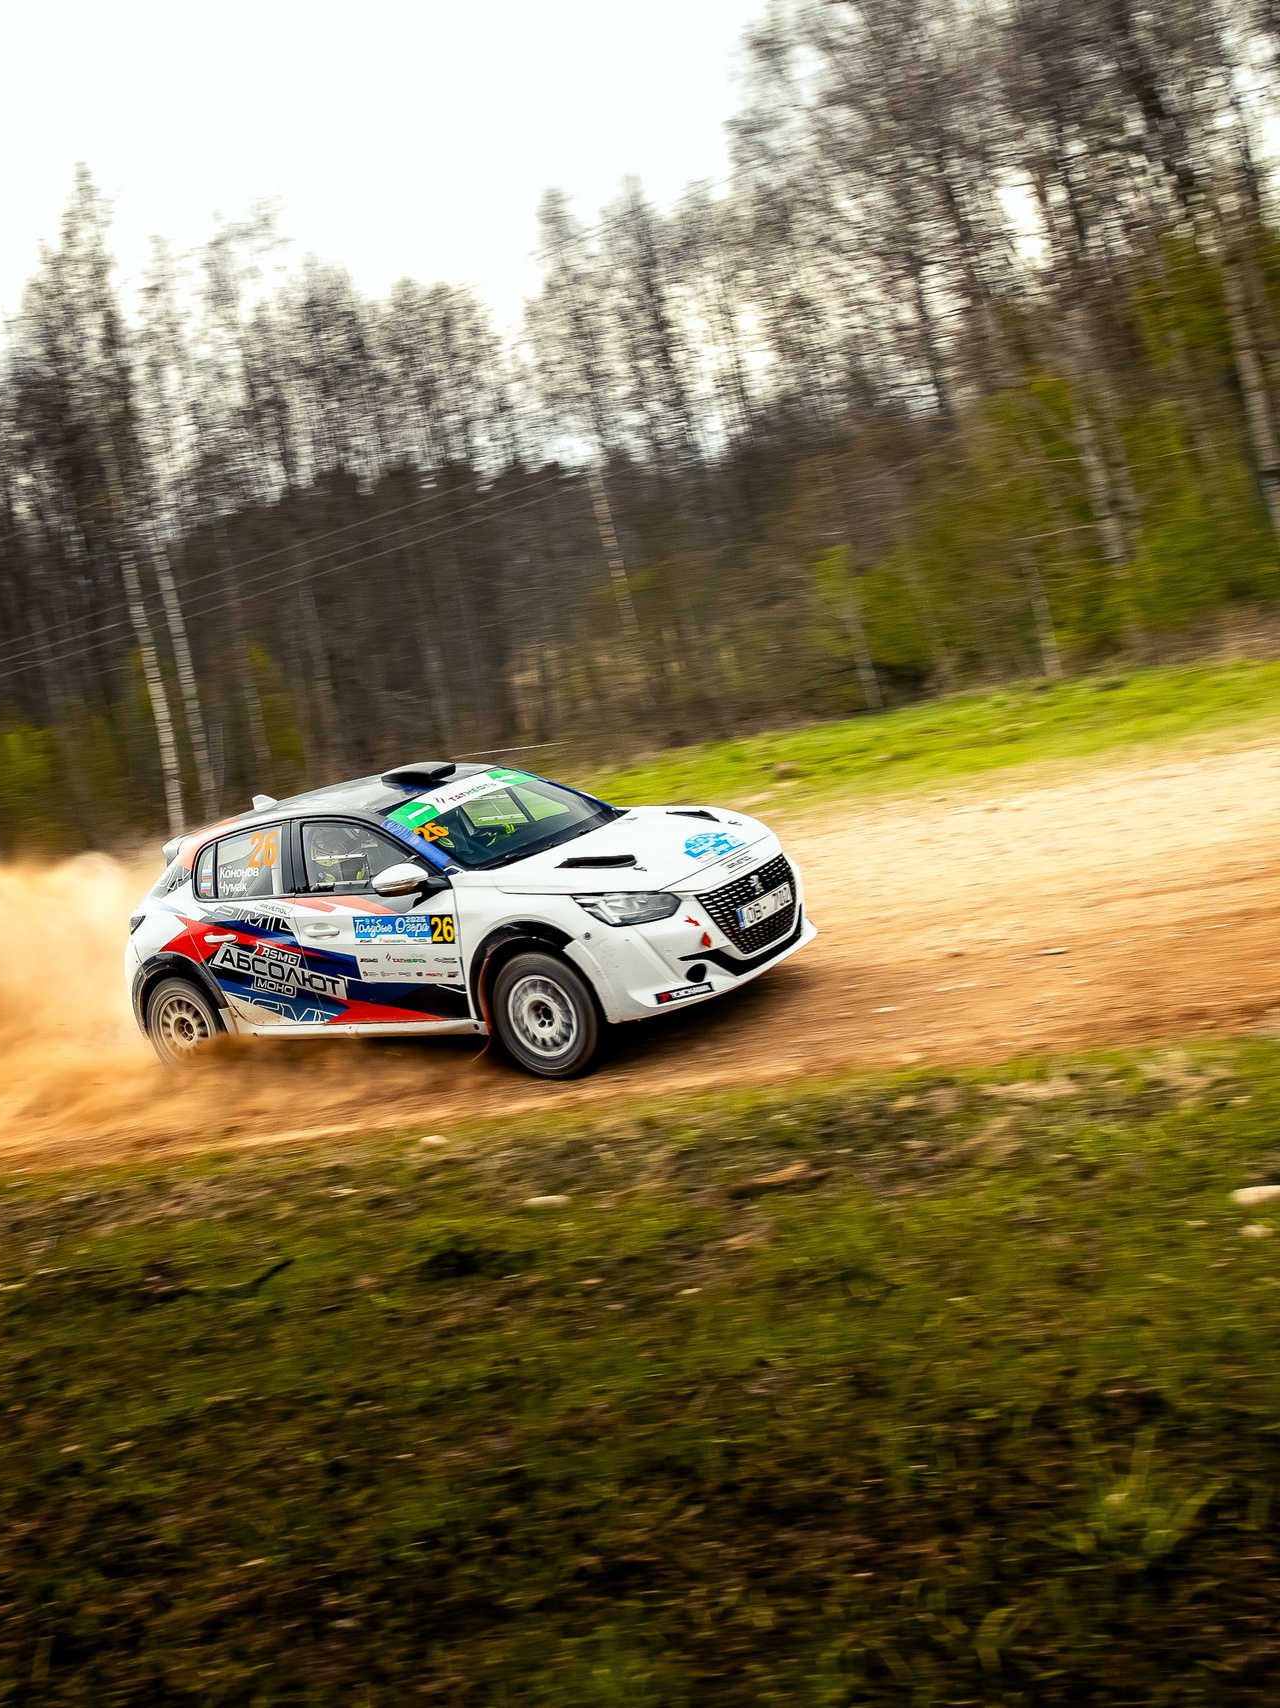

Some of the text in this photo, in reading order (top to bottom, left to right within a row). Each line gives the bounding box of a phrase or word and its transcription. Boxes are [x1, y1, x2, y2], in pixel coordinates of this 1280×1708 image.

[413, 822, 450, 842] 26
[248, 830, 277, 867] 26
[220, 866, 259, 879] Кононов
[220, 881, 248, 895] Чумак
[431, 916, 455, 942] 26
[261, 947, 297, 965] ASMG
[220, 949, 339, 995] АБСОЛЮТ
[257, 980, 294, 995] МОНО
